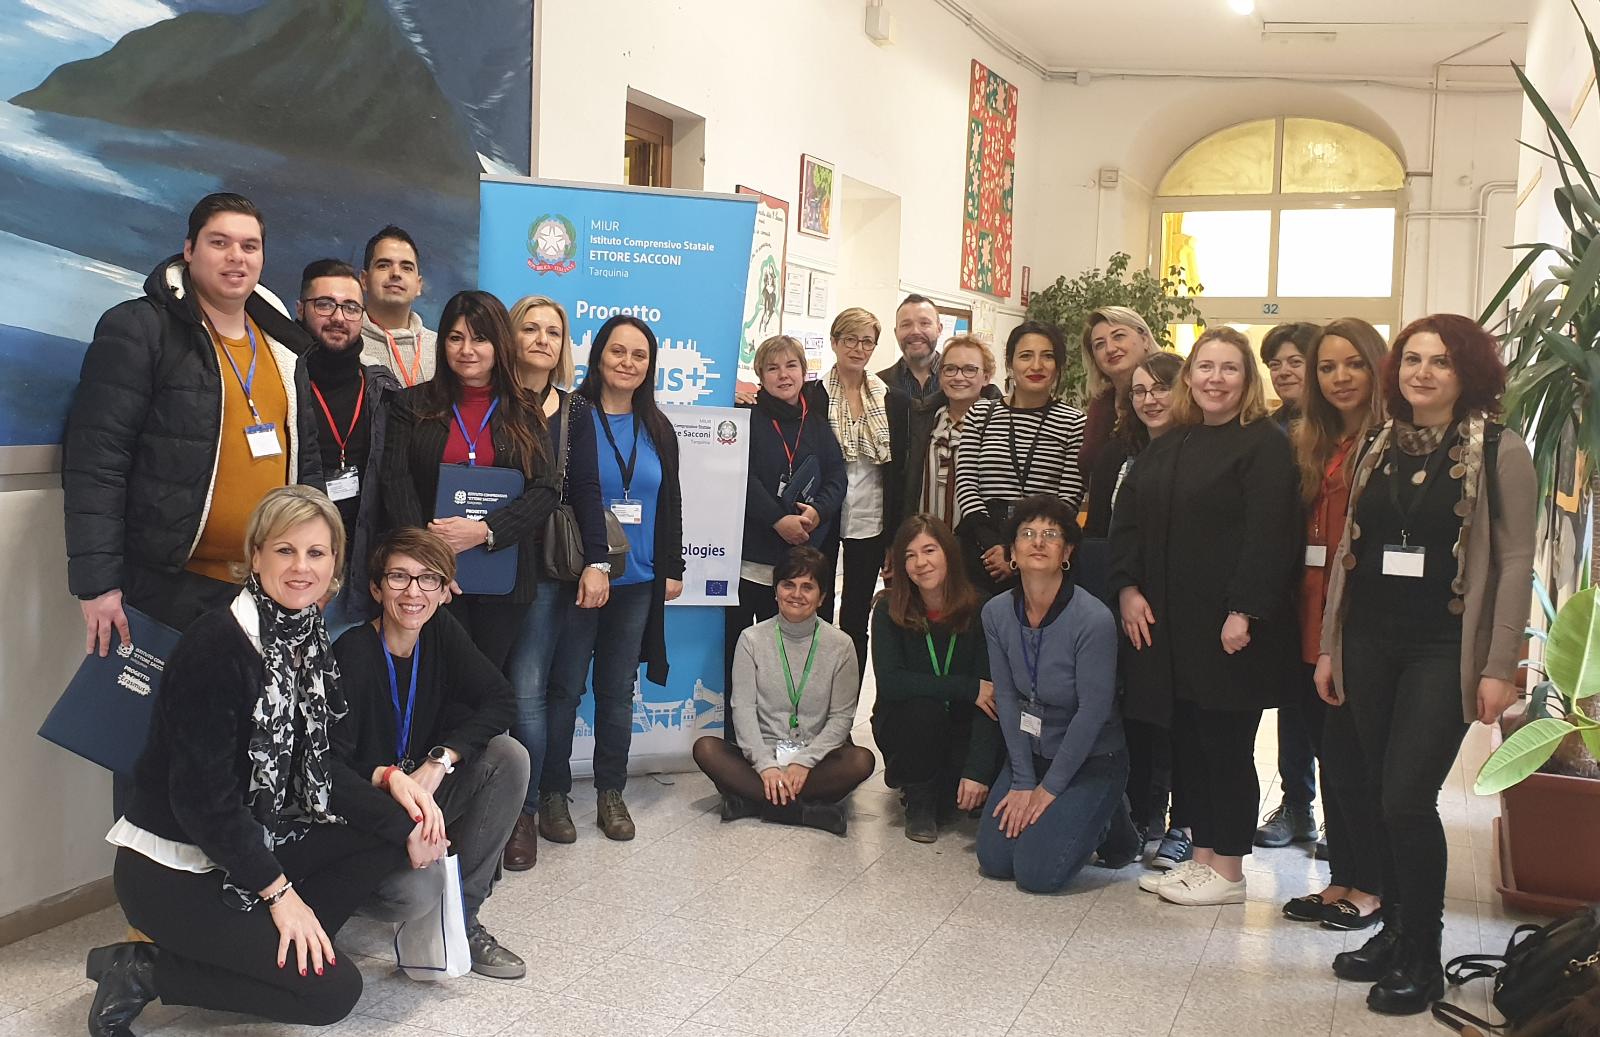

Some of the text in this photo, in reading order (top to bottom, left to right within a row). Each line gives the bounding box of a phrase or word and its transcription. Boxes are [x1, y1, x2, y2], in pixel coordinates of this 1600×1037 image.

[591, 220, 620, 231] MIUR
[590, 235, 715, 251] Istituto Comprensivo Statale
[589, 250, 681, 265] ETTORE SACCONI
[589, 267, 629, 277] Tarquinia
[1263, 304, 1279, 314] 32
[683, 430, 711, 438] Sacconi
[681, 543, 725, 558] ologies
